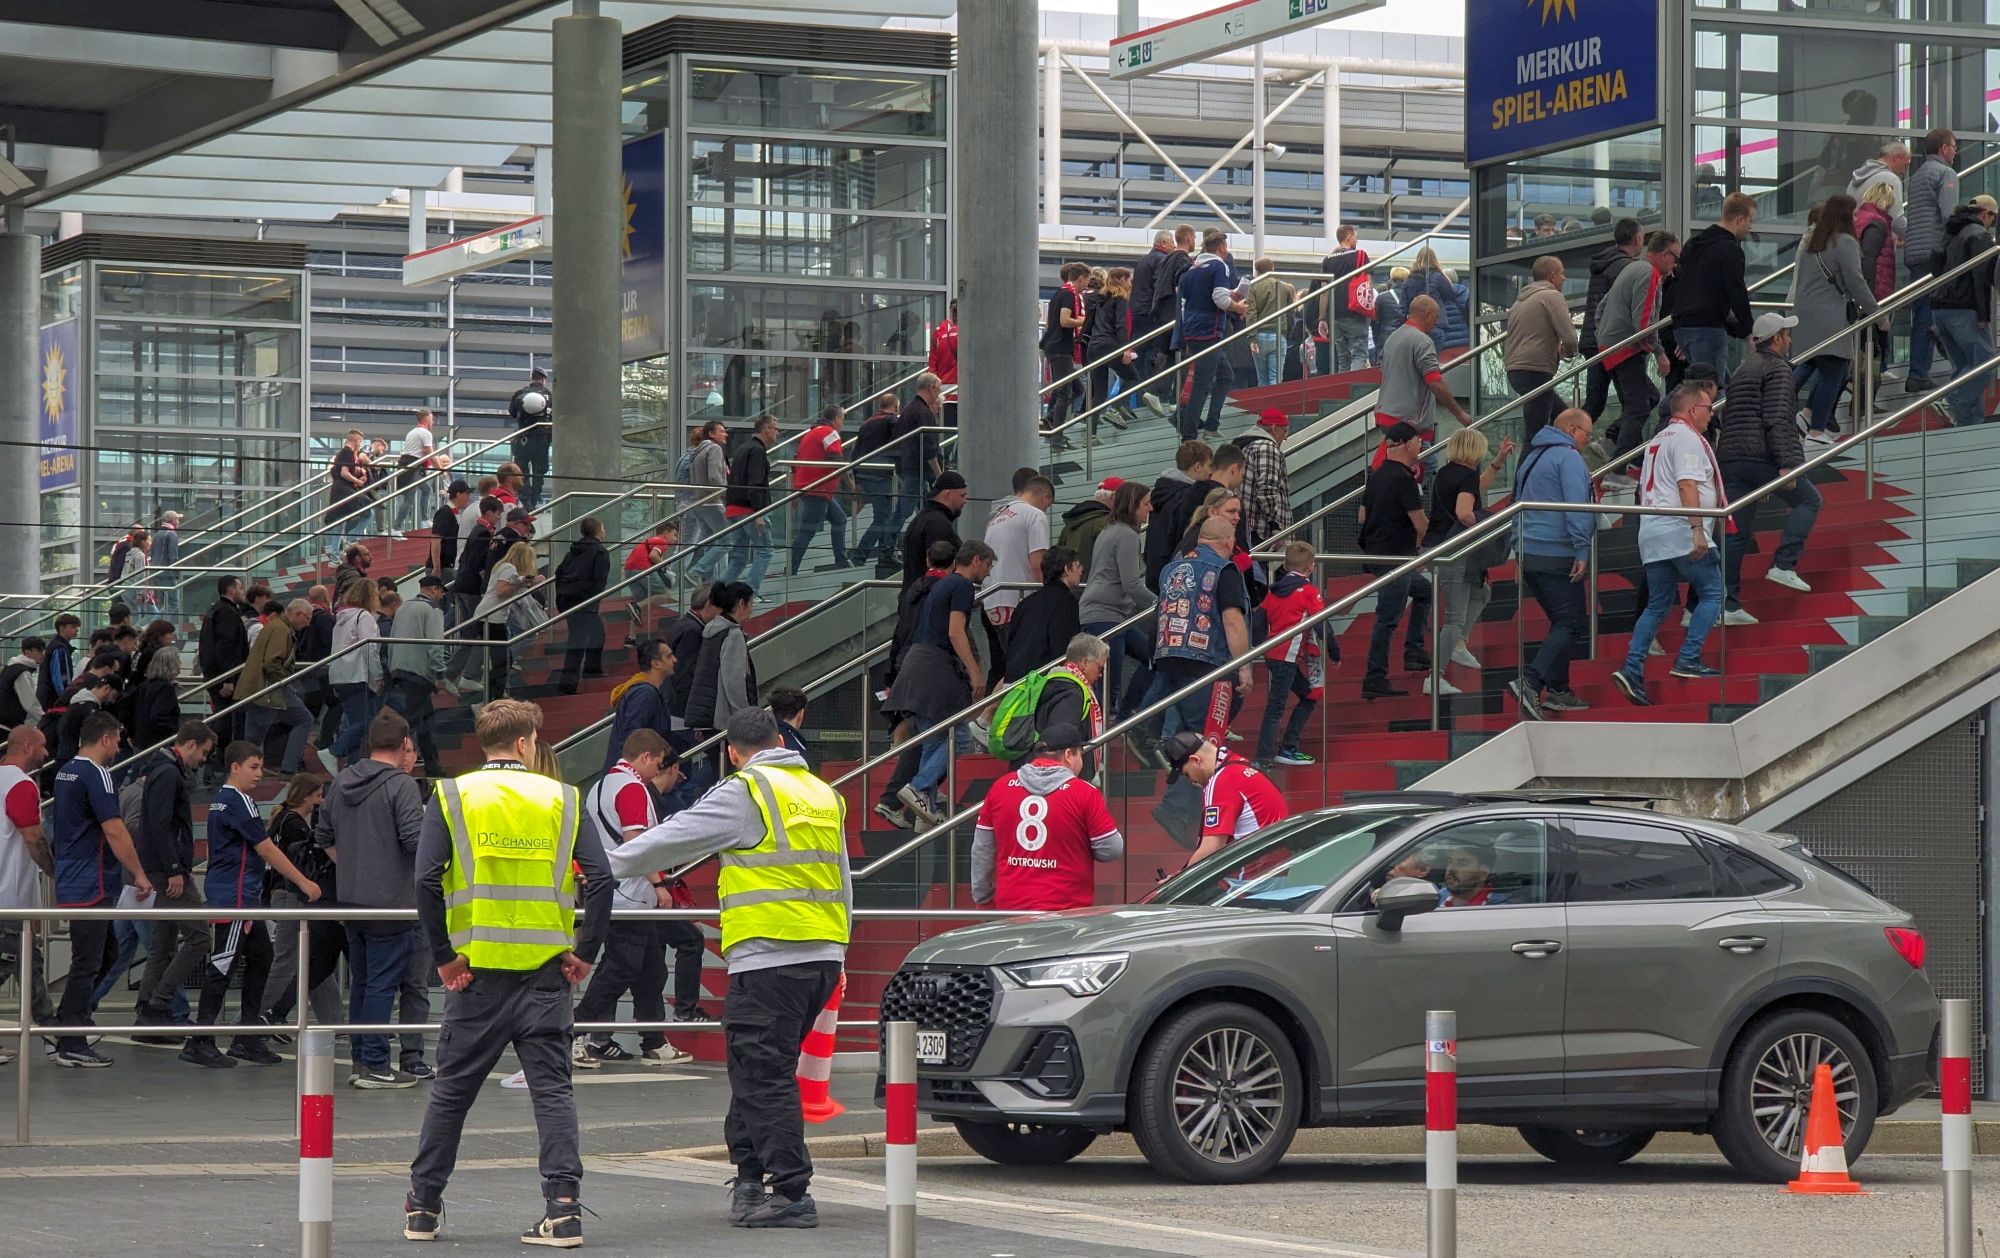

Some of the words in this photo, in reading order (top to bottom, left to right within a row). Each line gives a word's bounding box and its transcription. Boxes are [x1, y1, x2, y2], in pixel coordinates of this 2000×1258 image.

[1516, 36, 1602, 85] MERKUR
[1491, 69, 1628, 130] SPIEL-ARENA
[622, 290, 637, 313] UR
[1016, 795, 1048, 851] 8
[922, 1035, 945, 1056] 2309
